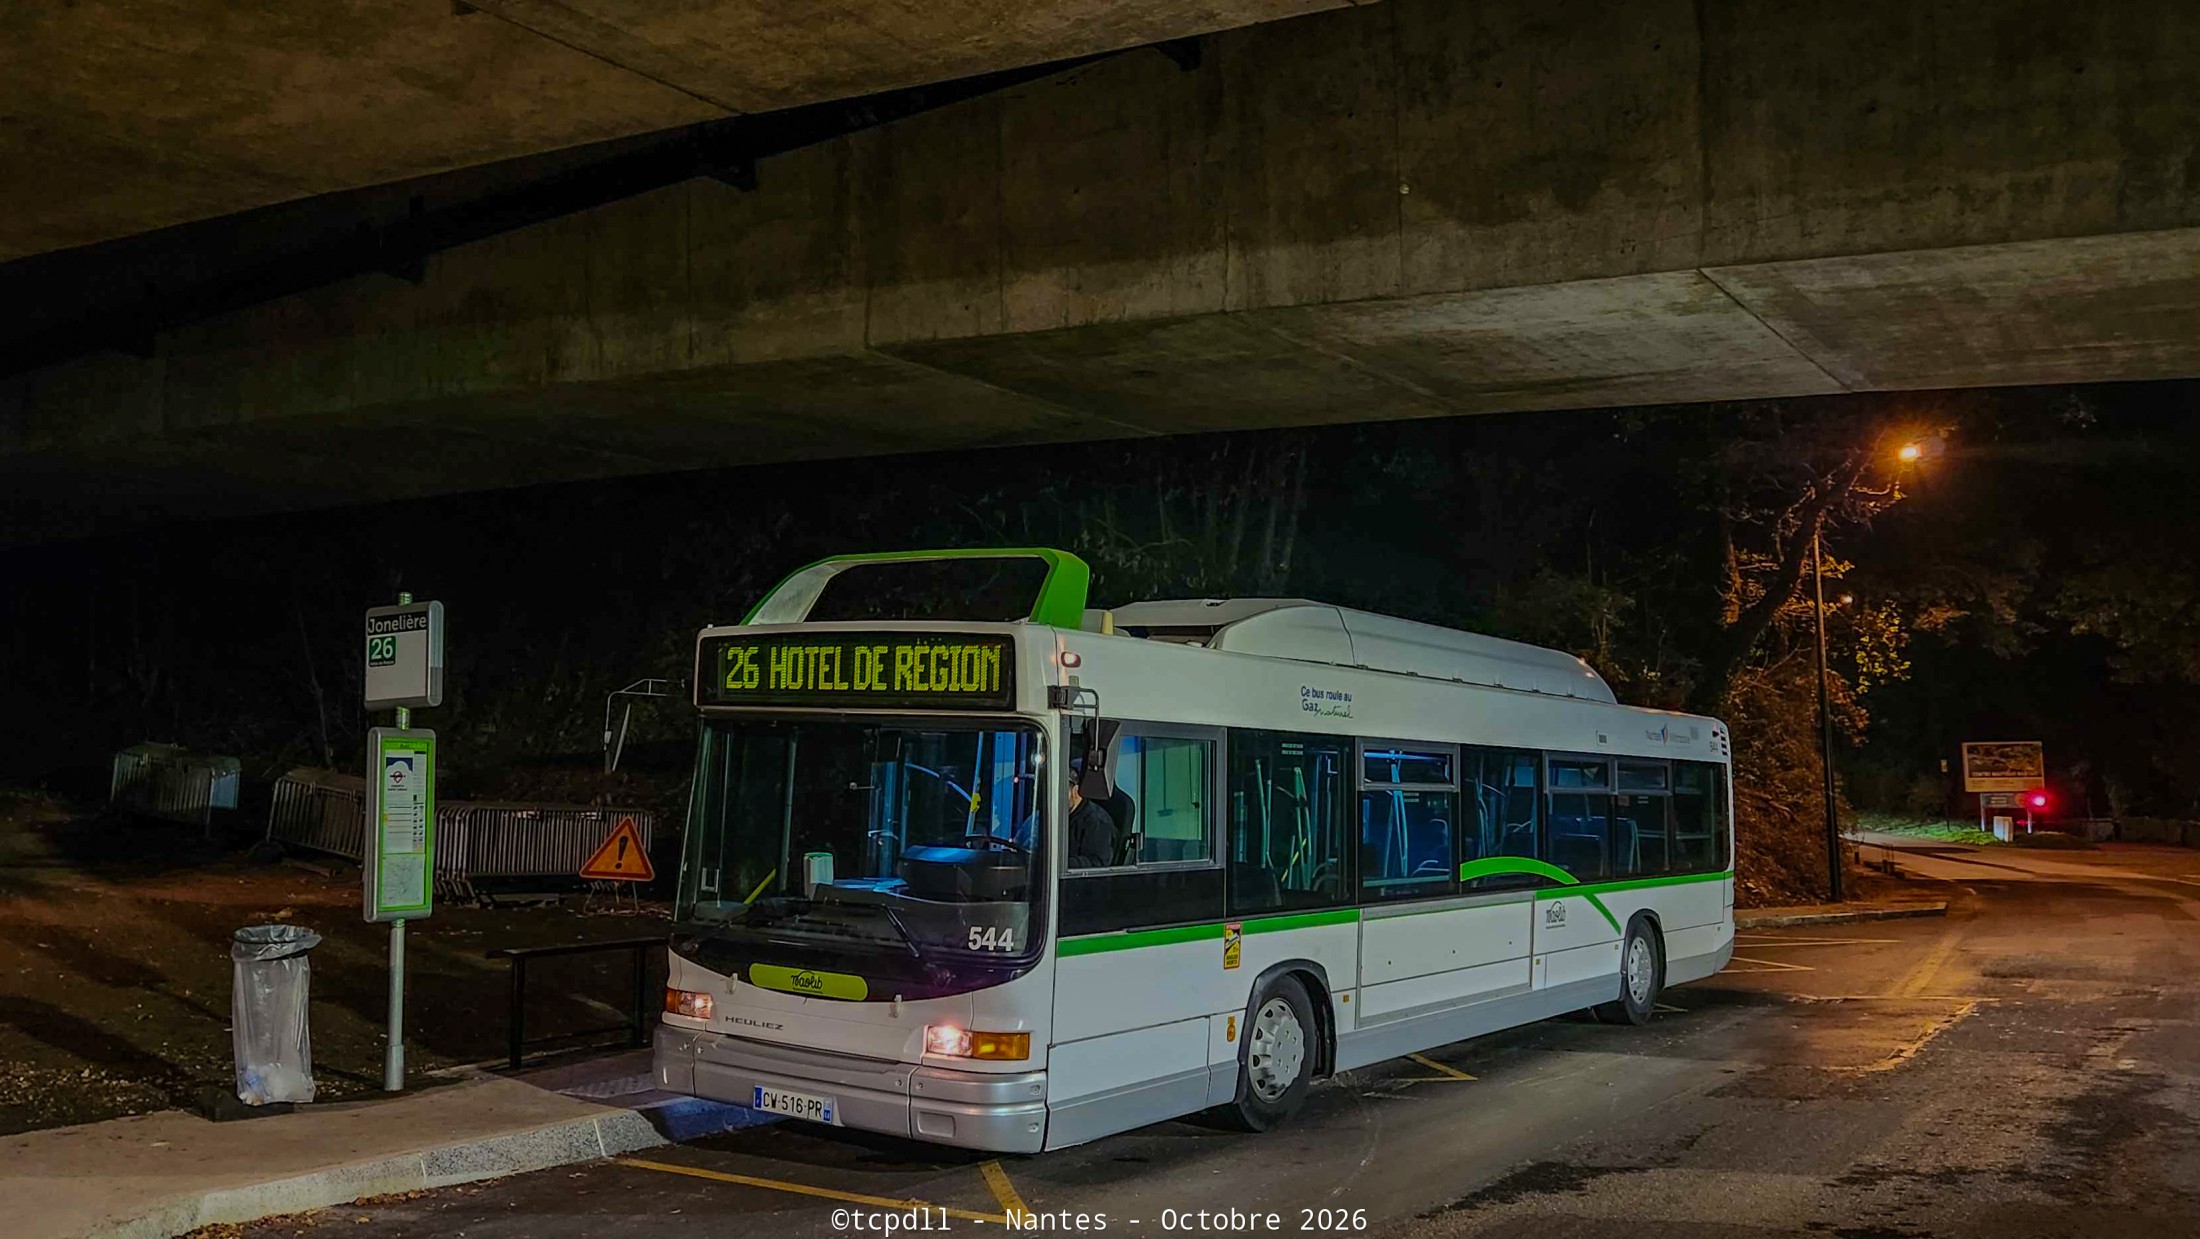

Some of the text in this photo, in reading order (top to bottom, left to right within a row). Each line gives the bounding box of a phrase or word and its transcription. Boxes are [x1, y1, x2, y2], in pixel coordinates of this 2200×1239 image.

[367, 614, 427, 634] Jonelière
[371, 637, 394, 660] 26
[726, 646, 760, 689] 26
[769, 645, 849, 690] HOTEL
[853, 645, 889, 690] DE
[1300, 685, 1352, 702] Ce bus roule au
[1302, 699, 1320, 712] Gaz
[968, 926, 1014, 951] 544
[725, 1016, 784, 1031] HEULIEZ
